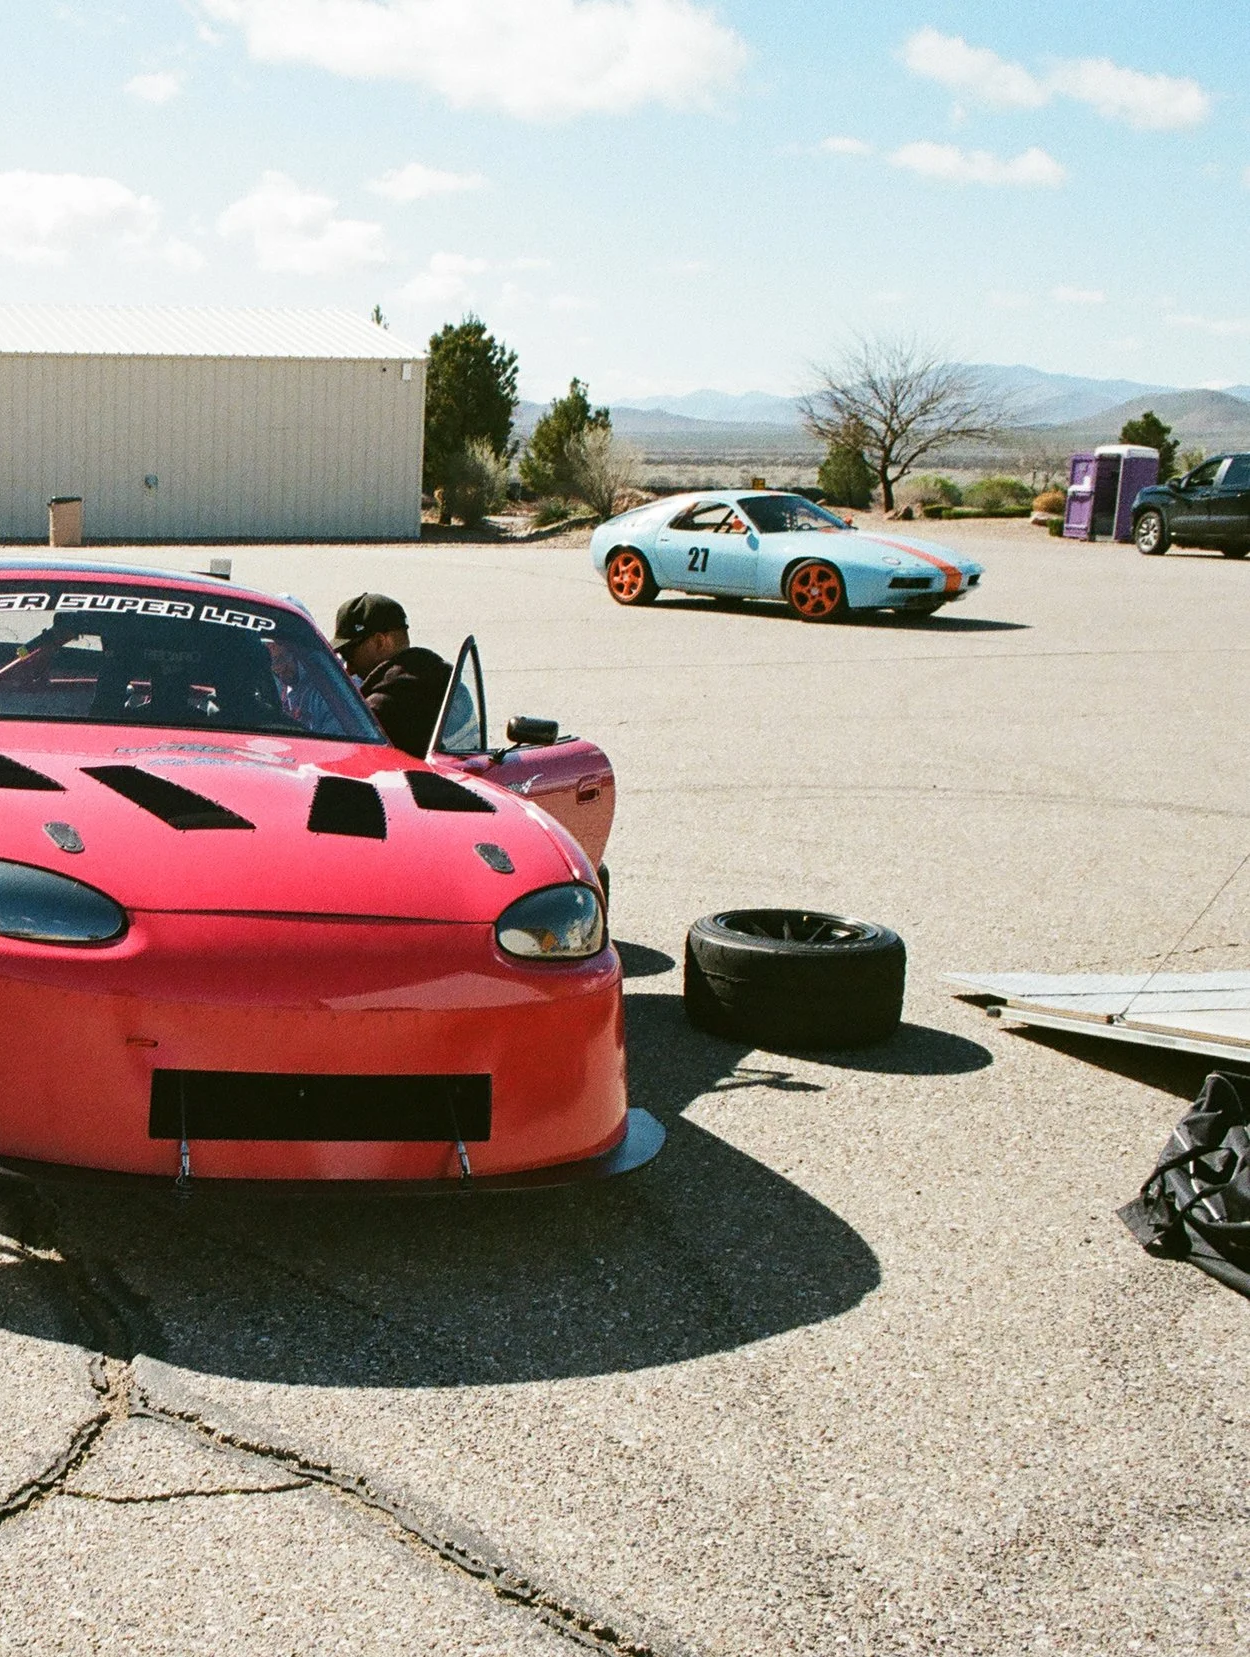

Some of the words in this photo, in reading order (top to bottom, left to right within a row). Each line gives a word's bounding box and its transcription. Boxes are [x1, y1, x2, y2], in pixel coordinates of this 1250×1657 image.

[688, 546, 710, 572] 27
[54, 592, 195, 620] SUPER
[199, 605, 277, 632] LAP
